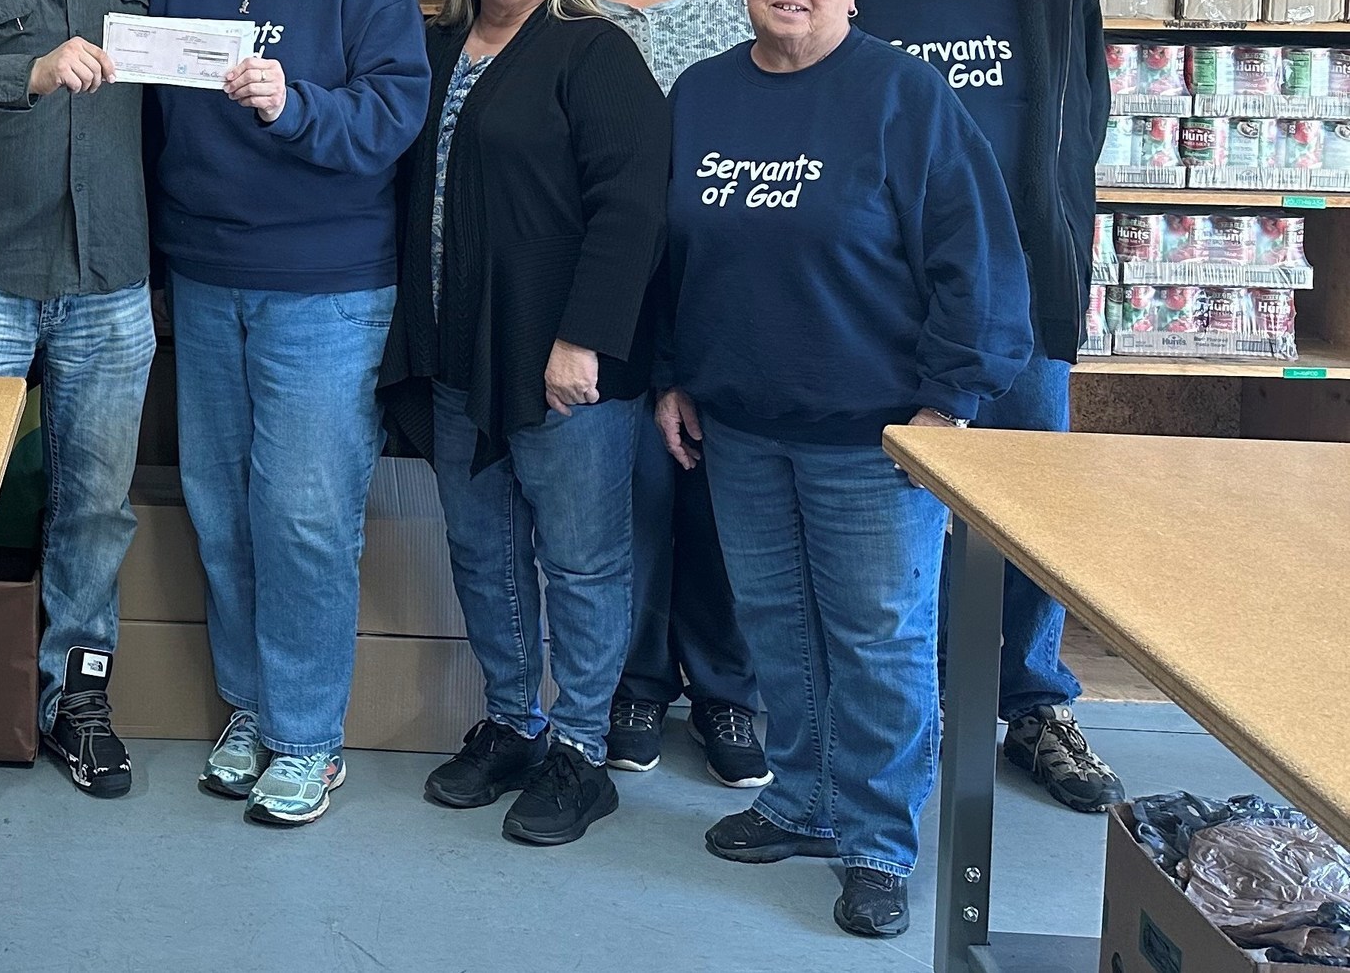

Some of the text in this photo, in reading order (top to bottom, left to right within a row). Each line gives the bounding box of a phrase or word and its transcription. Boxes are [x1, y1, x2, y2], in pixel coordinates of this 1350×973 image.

[947, 61, 1004, 88] God
[697, 152, 824, 181] Servants
[701, 181, 802, 208] of God
